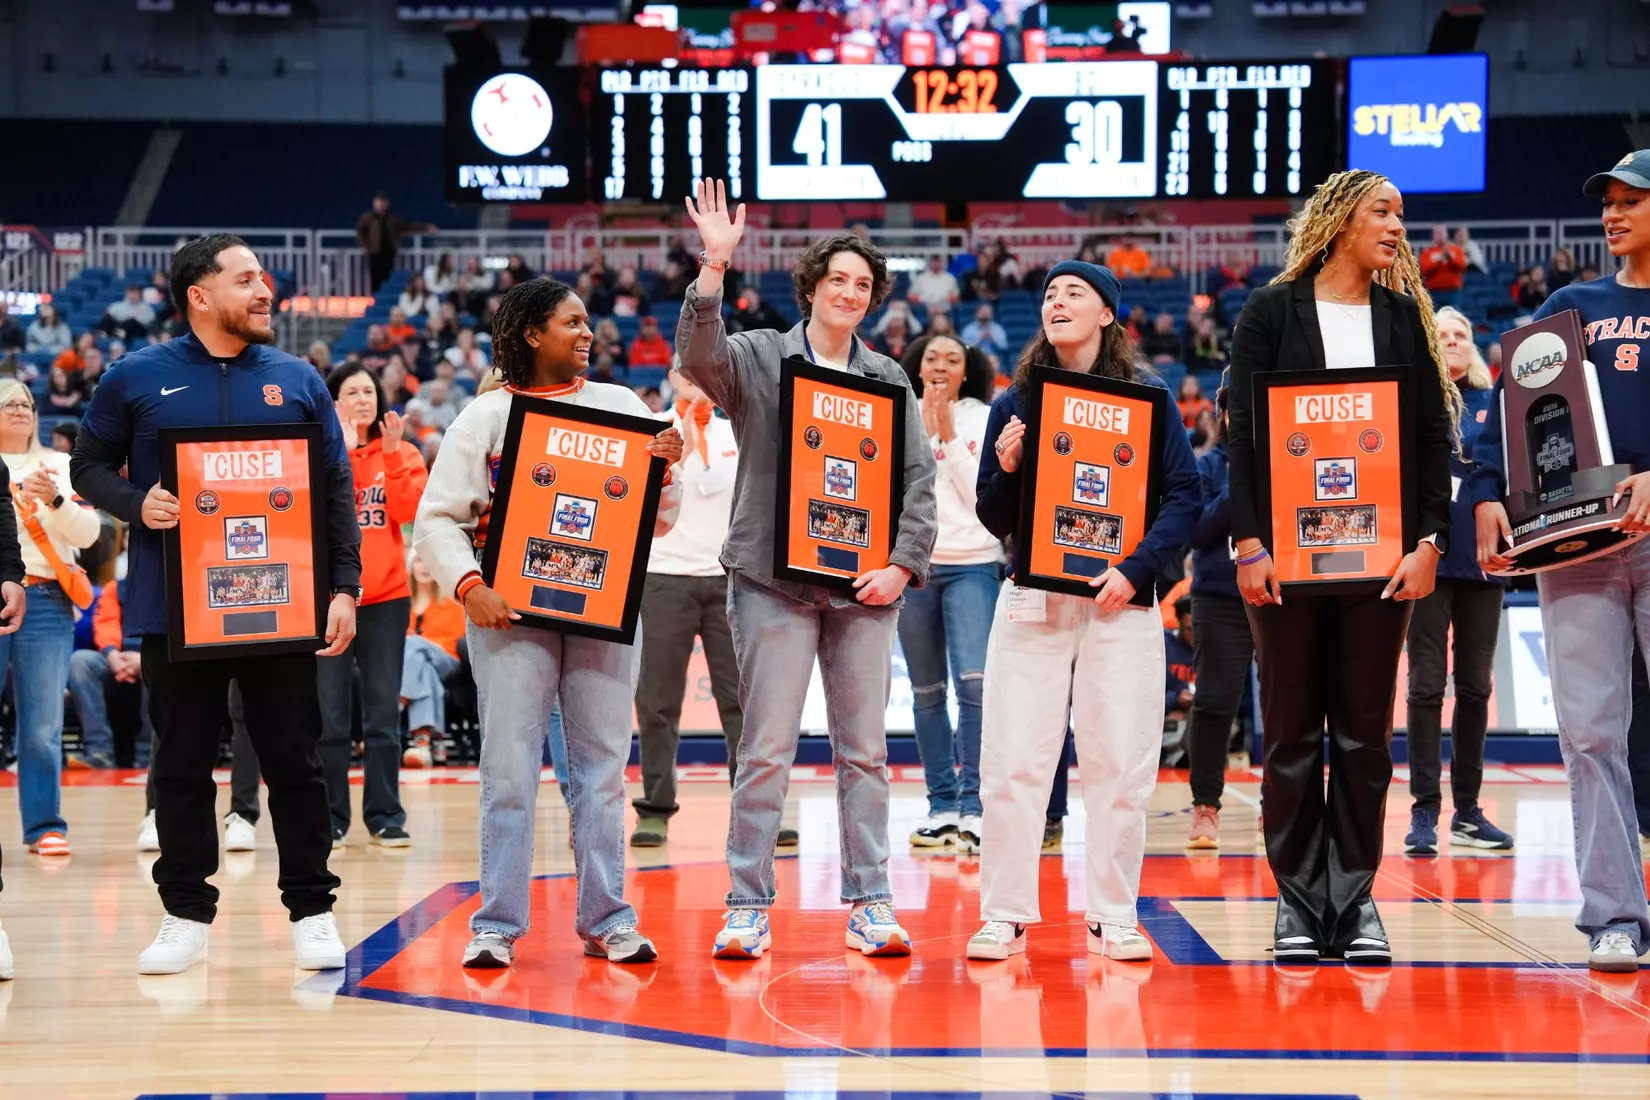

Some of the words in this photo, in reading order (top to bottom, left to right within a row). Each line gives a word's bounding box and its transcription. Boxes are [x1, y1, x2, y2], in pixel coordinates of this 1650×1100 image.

[912, 70, 998, 113] 12:32
[1065, 101, 1122, 163] 30
[1353, 102, 1481, 135] STELLAR
[793, 103, 841, 166] 41
[1516, 351, 1564, 379] NCAA
[1614, 344, 1640, 371] S
[263, 384, 283, 406] S
[1298, 394, 1365, 421] 'CUSE
[816, 393, 867, 428] 'CUSE
[1067, 399, 1123, 432] 'CUSE
[1534, 407, 1565, 424] DIVISION
[553, 430, 620, 465] 'CUSE
[207, 452, 275, 479] 'CUSE
[1320, 477, 1335, 485] FINAL
[1335, 476, 1350, 484] FOUR
[358, 509, 385, 526] 33
[558, 512, 574, 521] FINAL
[574, 515, 588, 525] FOUR
[1512, 514, 1546, 538] ATIONAL
[1547, 503, 1599, 525] RUNNER-UP
[231, 535, 247, 543] FINAL
[247, 534, 261, 542] FOUR
